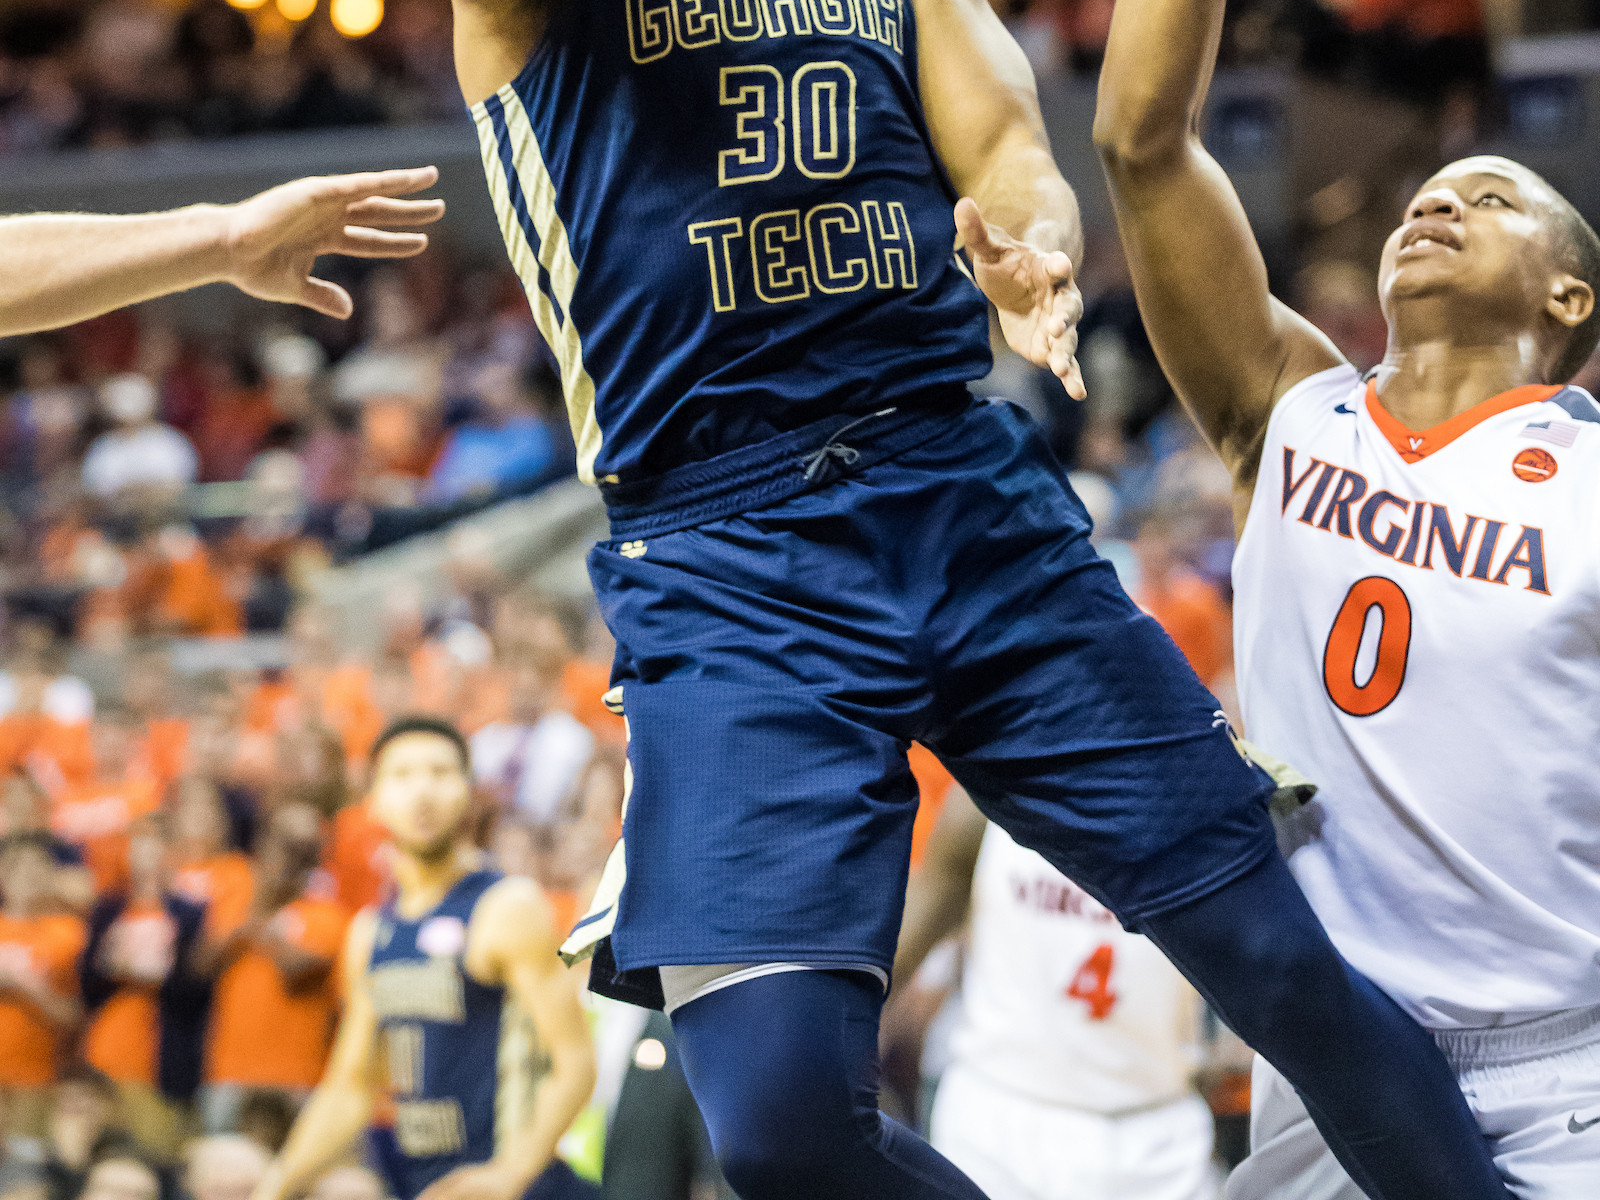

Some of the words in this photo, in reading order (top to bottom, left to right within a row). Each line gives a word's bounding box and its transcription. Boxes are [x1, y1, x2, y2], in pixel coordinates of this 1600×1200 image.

[718, 60, 857, 187] 30
[688, 200, 918, 312] TECH
[1281, 445, 1552, 596] VIRGINIA
[1322, 575, 1411, 717] 0
[1066, 942, 1117, 1022] 4
